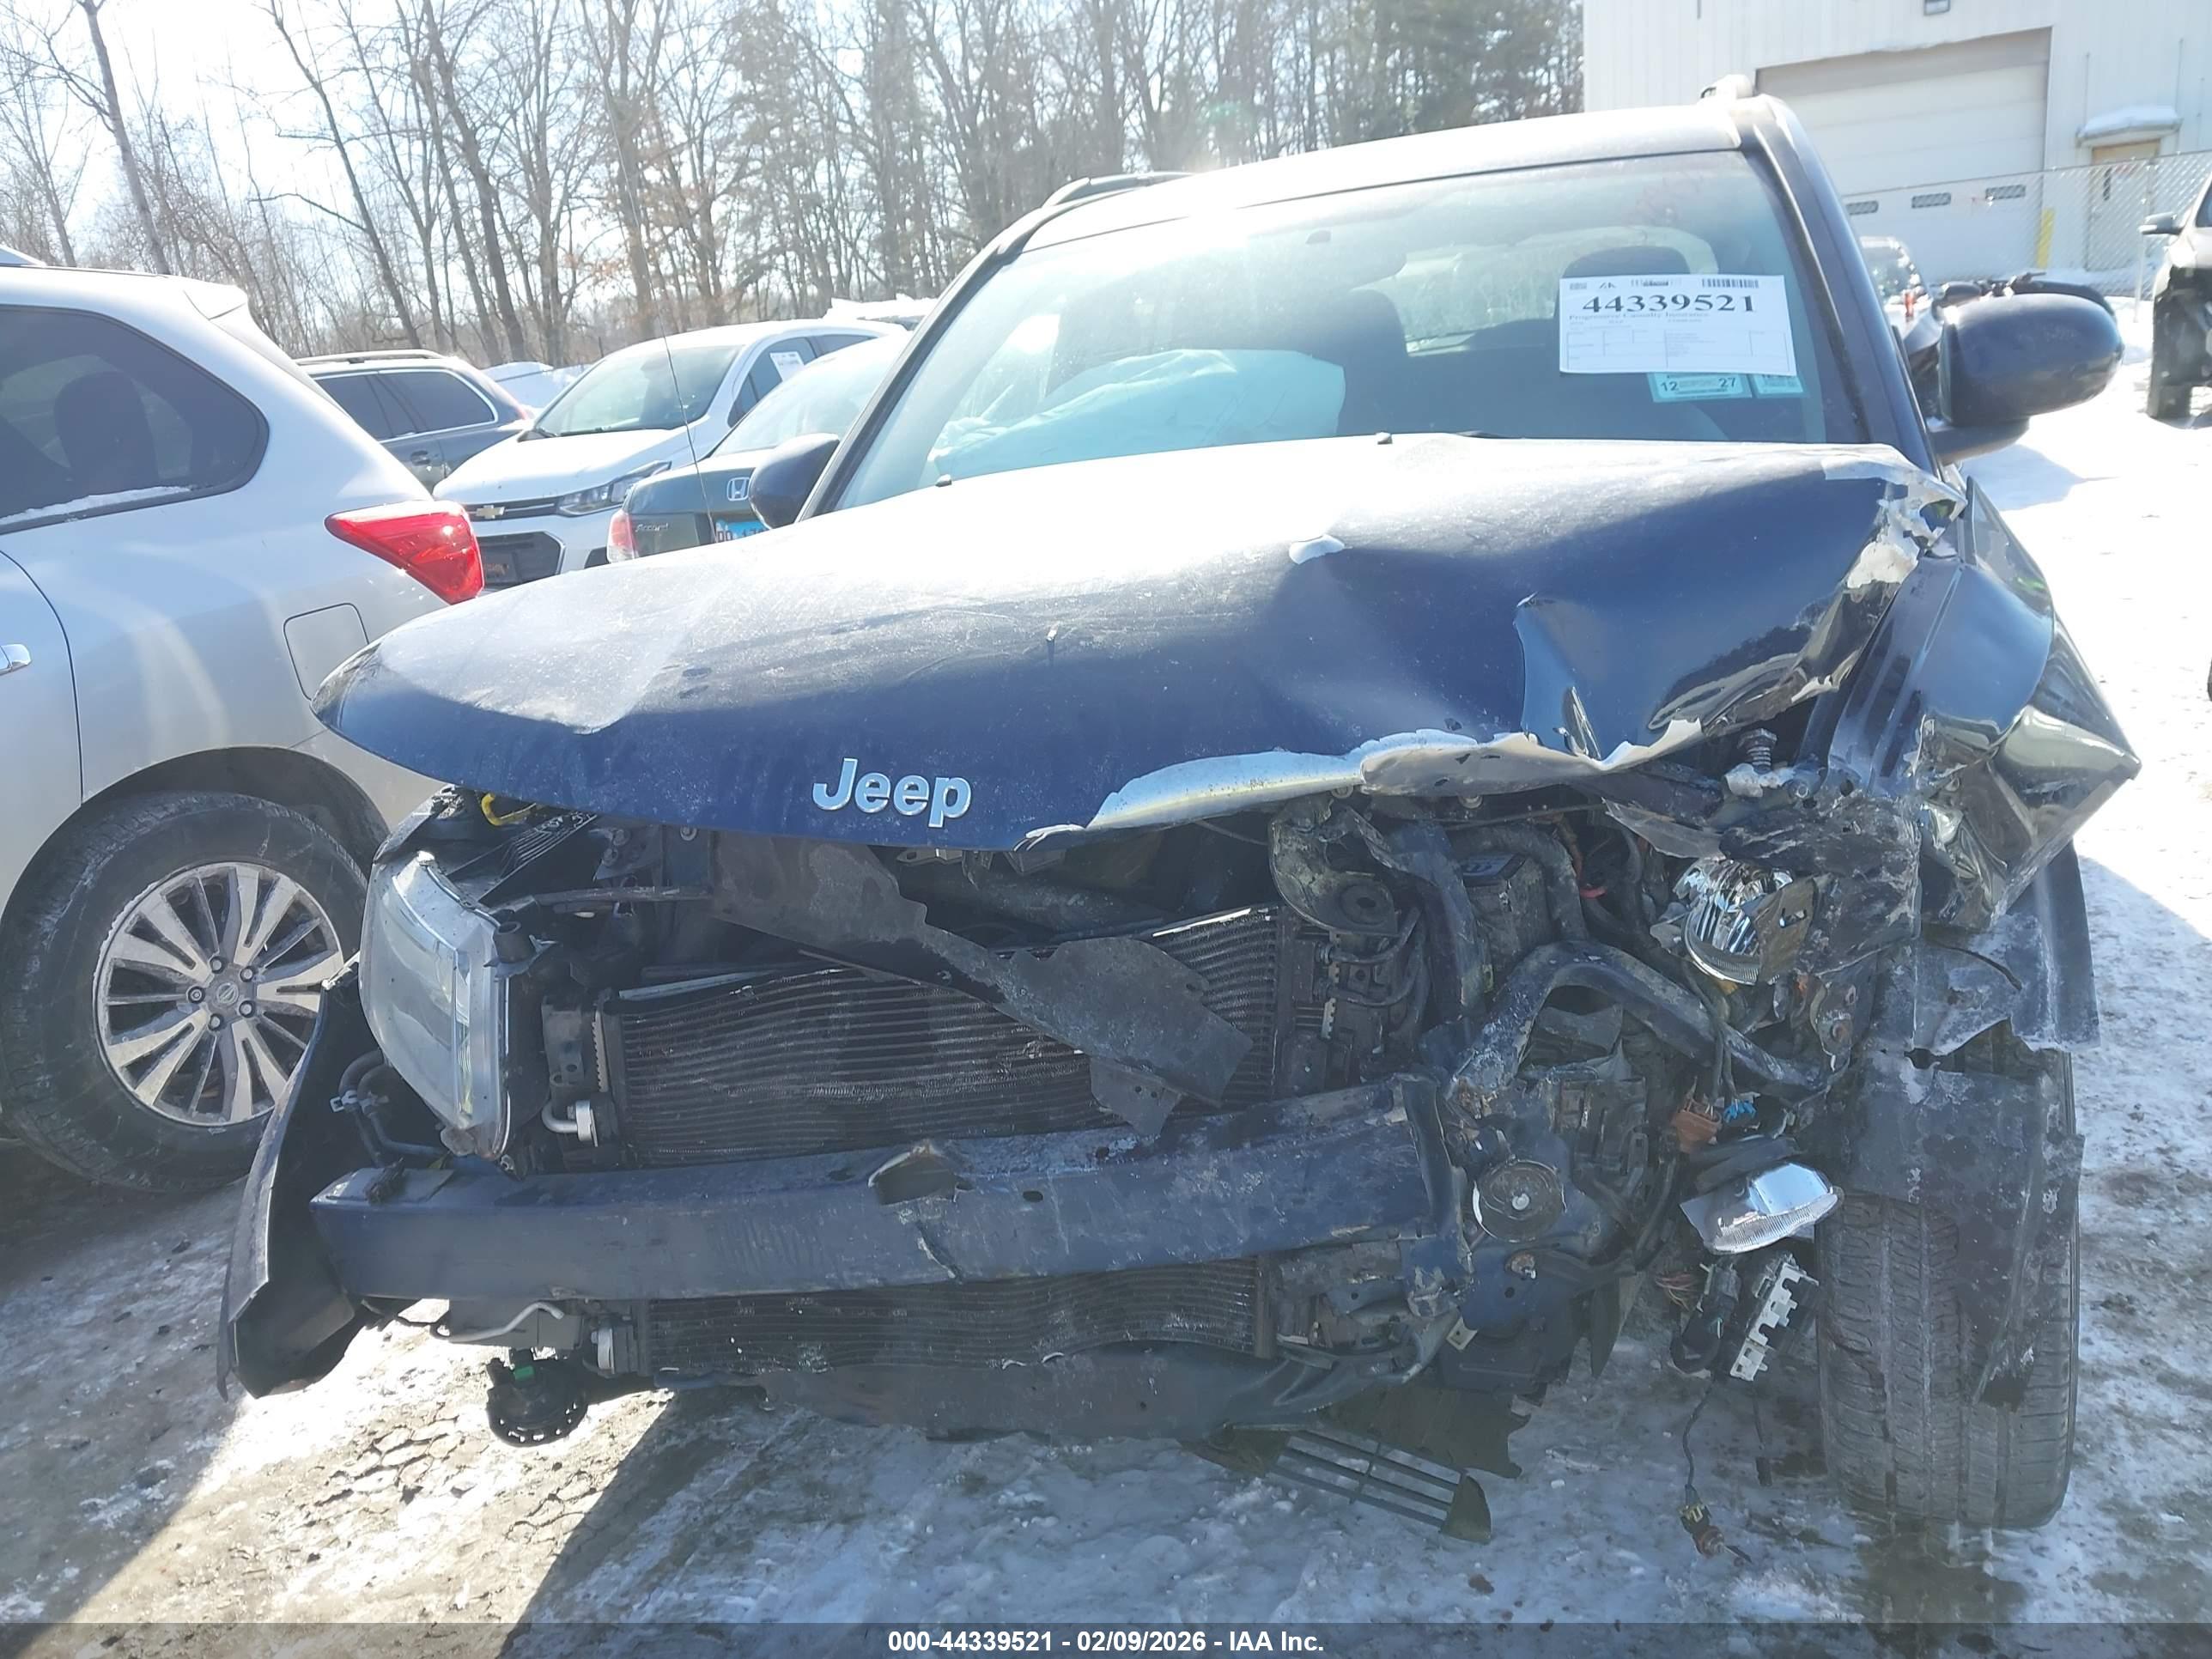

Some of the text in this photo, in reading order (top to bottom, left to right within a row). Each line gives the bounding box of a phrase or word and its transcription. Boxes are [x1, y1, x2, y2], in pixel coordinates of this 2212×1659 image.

[1583, 294, 1757, 313] 44339521
[1661, 380, 1678, 392] 12
[1718, 377, 1735, 388] 27
[812, 757, 971, 828] Jeep
